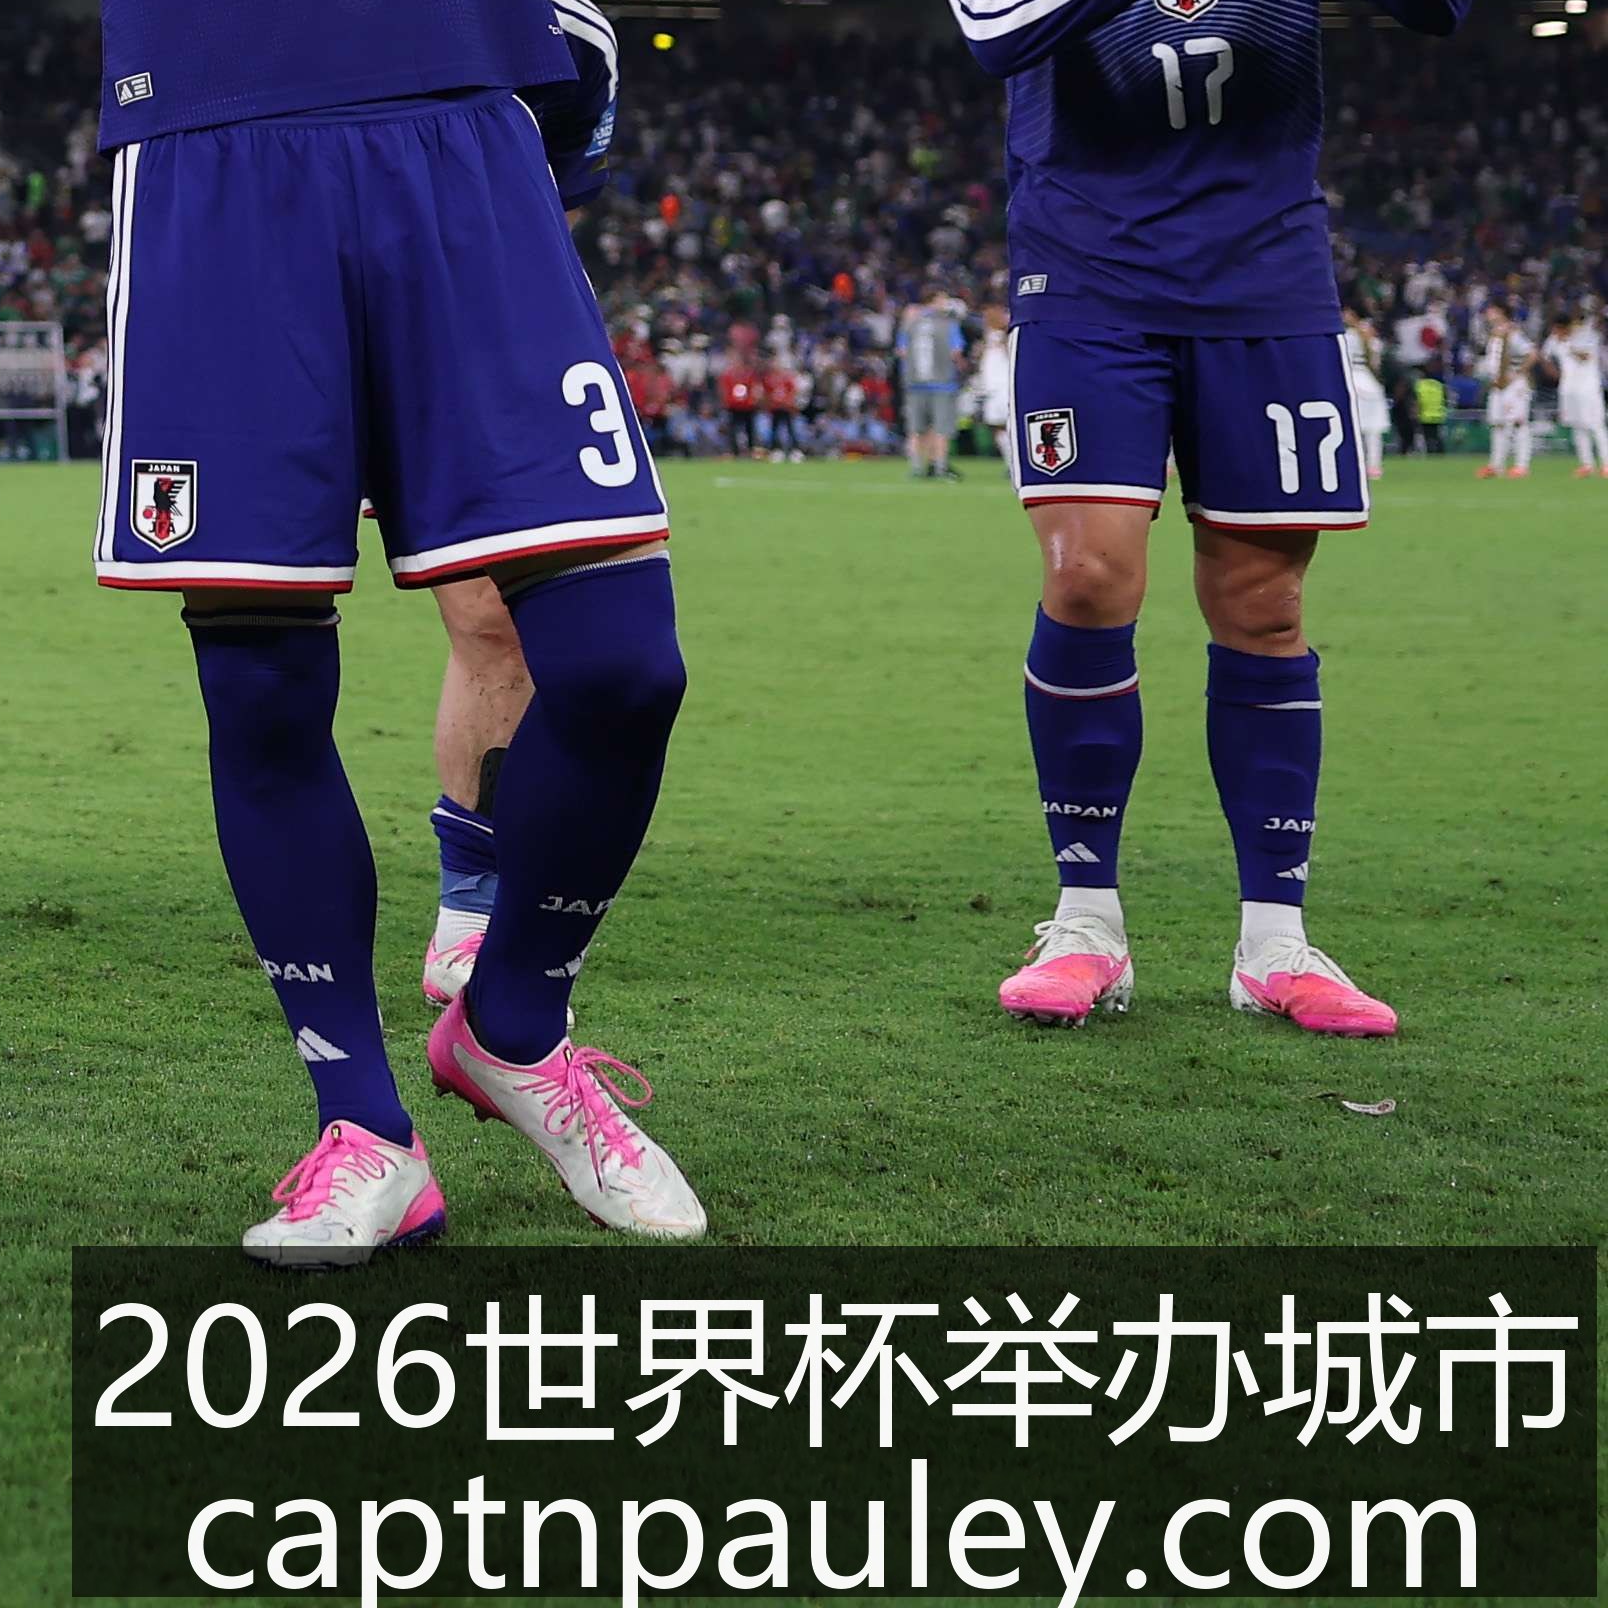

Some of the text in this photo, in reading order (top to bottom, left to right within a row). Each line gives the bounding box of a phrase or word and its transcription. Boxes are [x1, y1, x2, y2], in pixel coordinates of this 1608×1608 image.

[1151, 36, 1234, 130] 17
[147, 463, 181, 473] JAPAN
[562, 361, 637, 487] 3
[1266, 401, 1344, 494] 17
[257, 954, 335, 983] PAN
